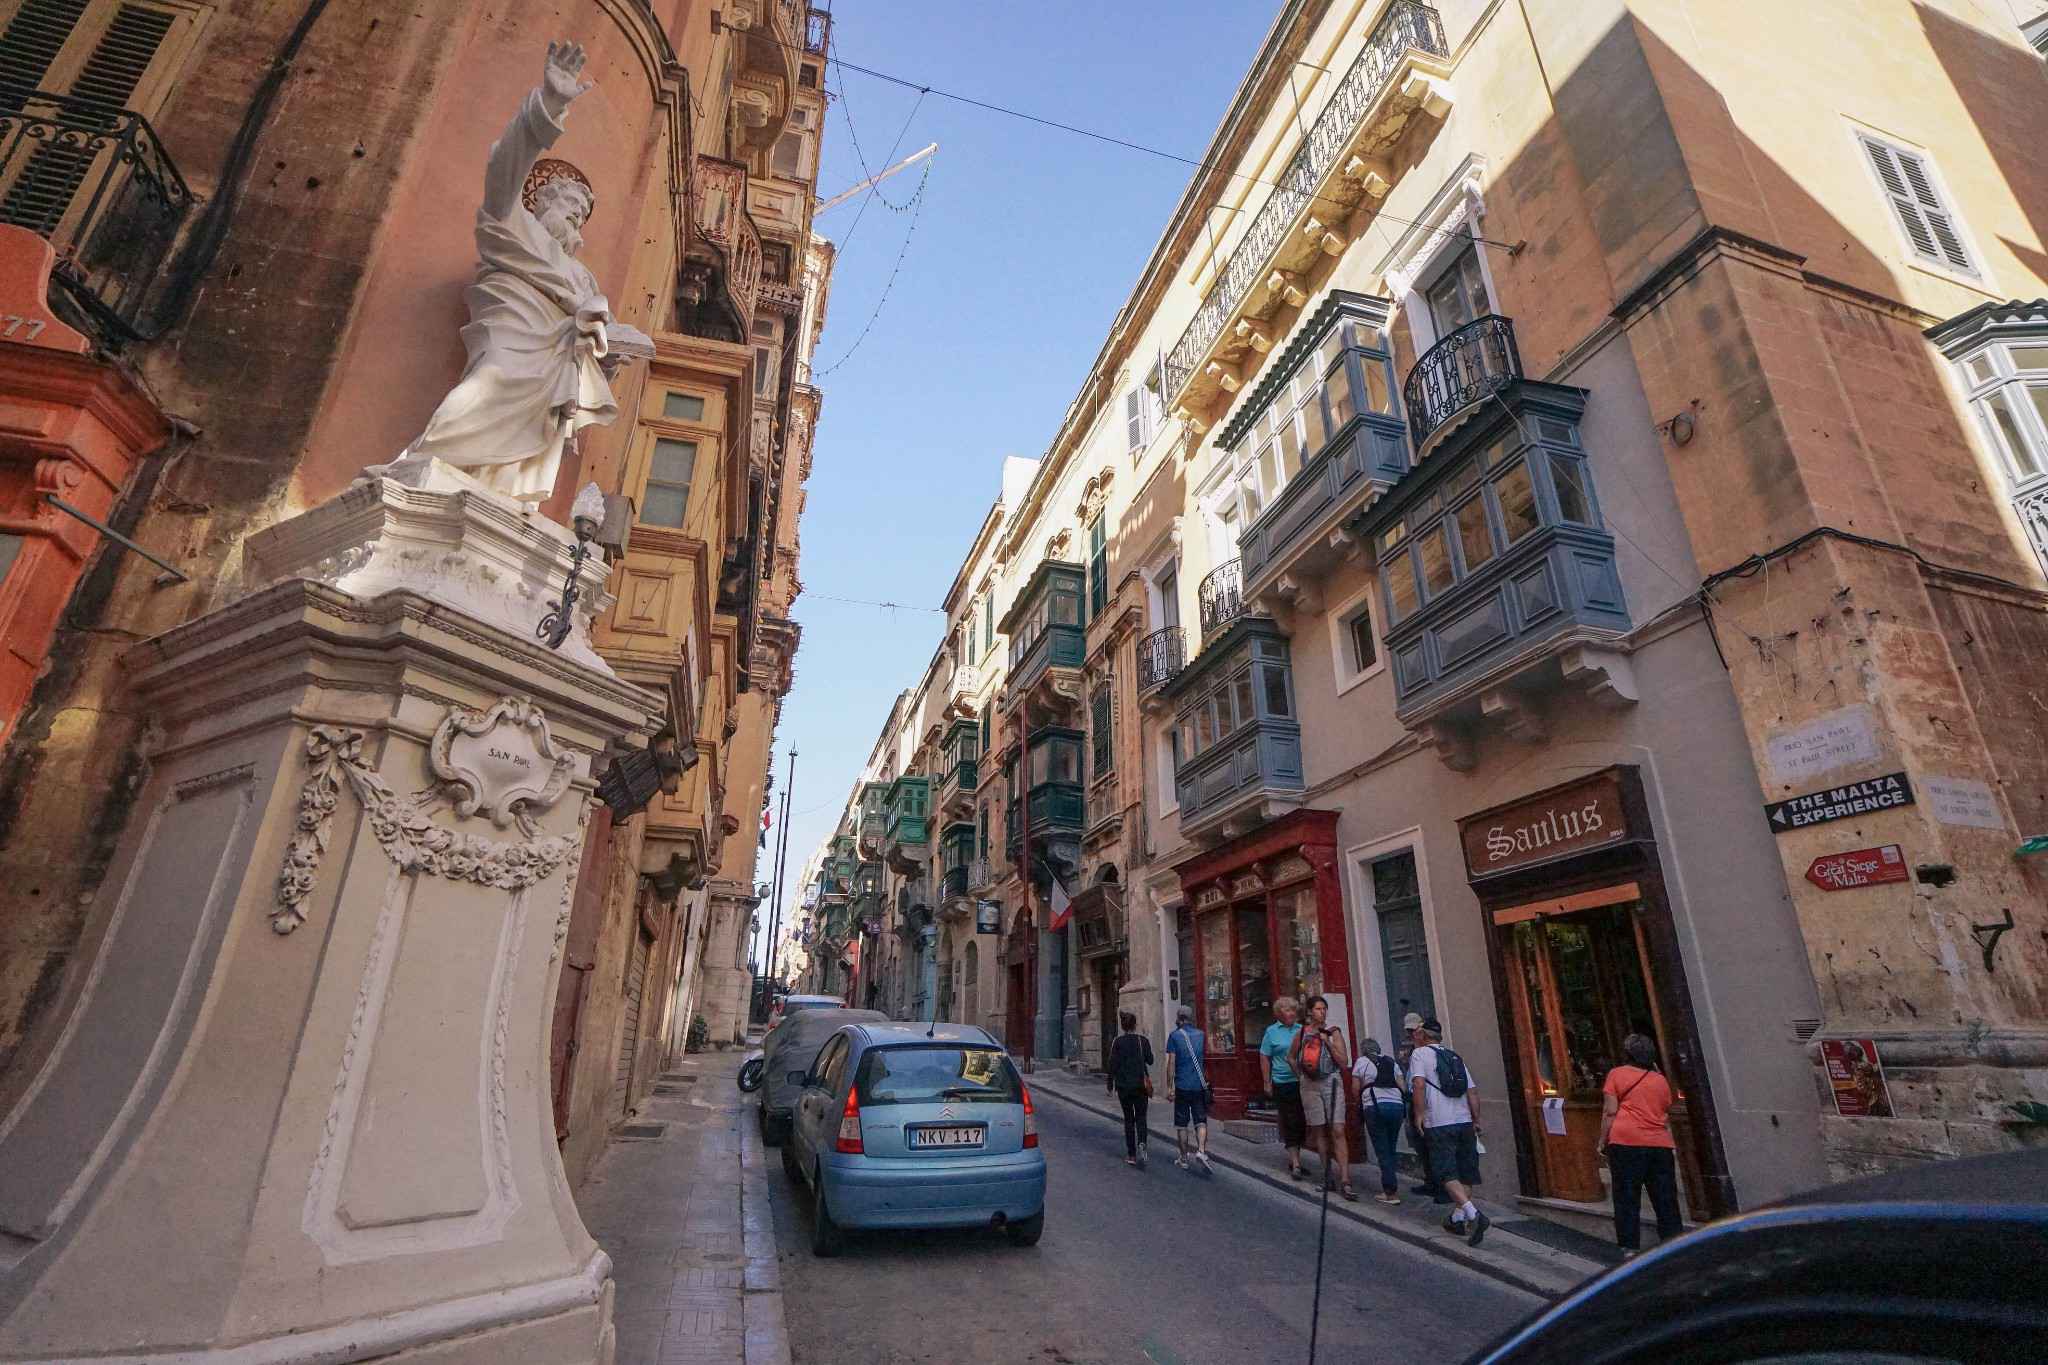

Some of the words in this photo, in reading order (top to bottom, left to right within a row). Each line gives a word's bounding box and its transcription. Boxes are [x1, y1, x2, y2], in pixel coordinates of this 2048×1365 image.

[488, 747, 511, 760] SAN
[1788, 793, 1825, 812] THE
[1832, 777, 1901, 803] MALTA
[1792, 790, 1905, 827] EXPERIENCE
[1486, 800, 1603, 861] Saulus
[1814, 863, 1845, 878] Great
[1846, 859, 1879, 873] Siege
[1832, 873, 1868, 888] Malta
[918, 1130, 946, 1145] NKV
[953, 1129, 981, 1143] 117
